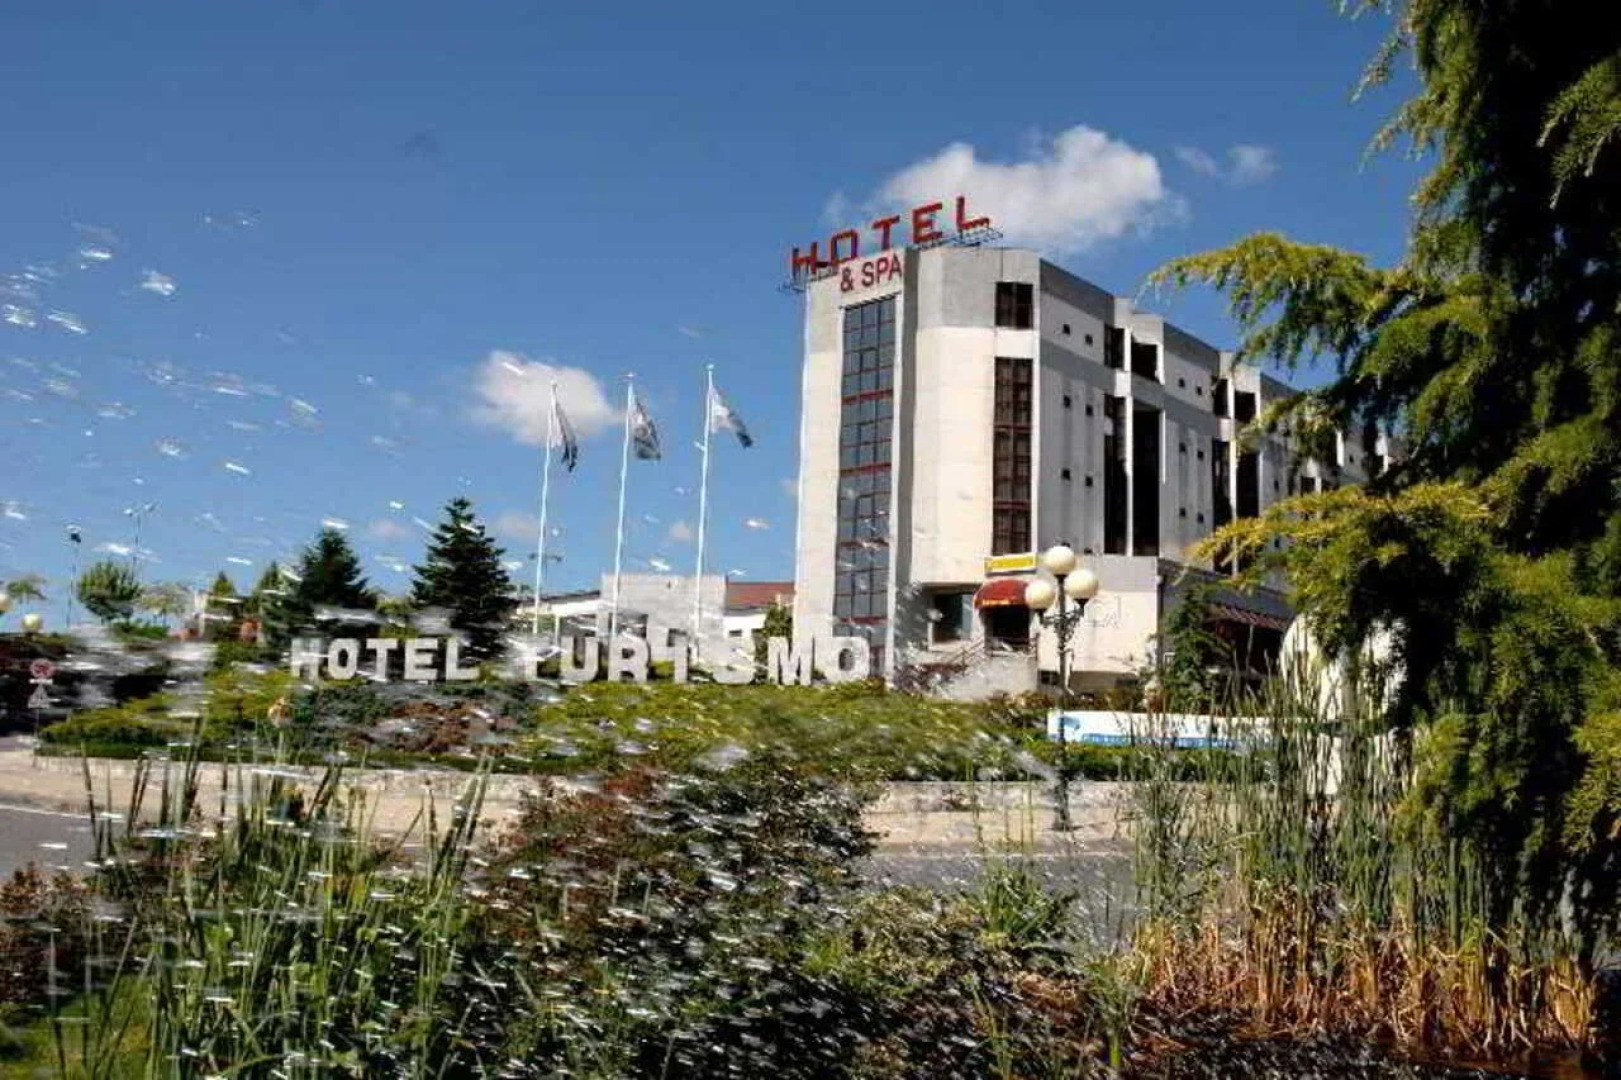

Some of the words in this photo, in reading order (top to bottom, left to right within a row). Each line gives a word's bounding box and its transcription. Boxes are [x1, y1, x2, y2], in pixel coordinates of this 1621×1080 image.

[791, 196, 990, 275] HOTEL
[840, 267, 854, 292] &
[862, 255, 903, 287] SPA
[290, 637, 479, 682] HOTEL
